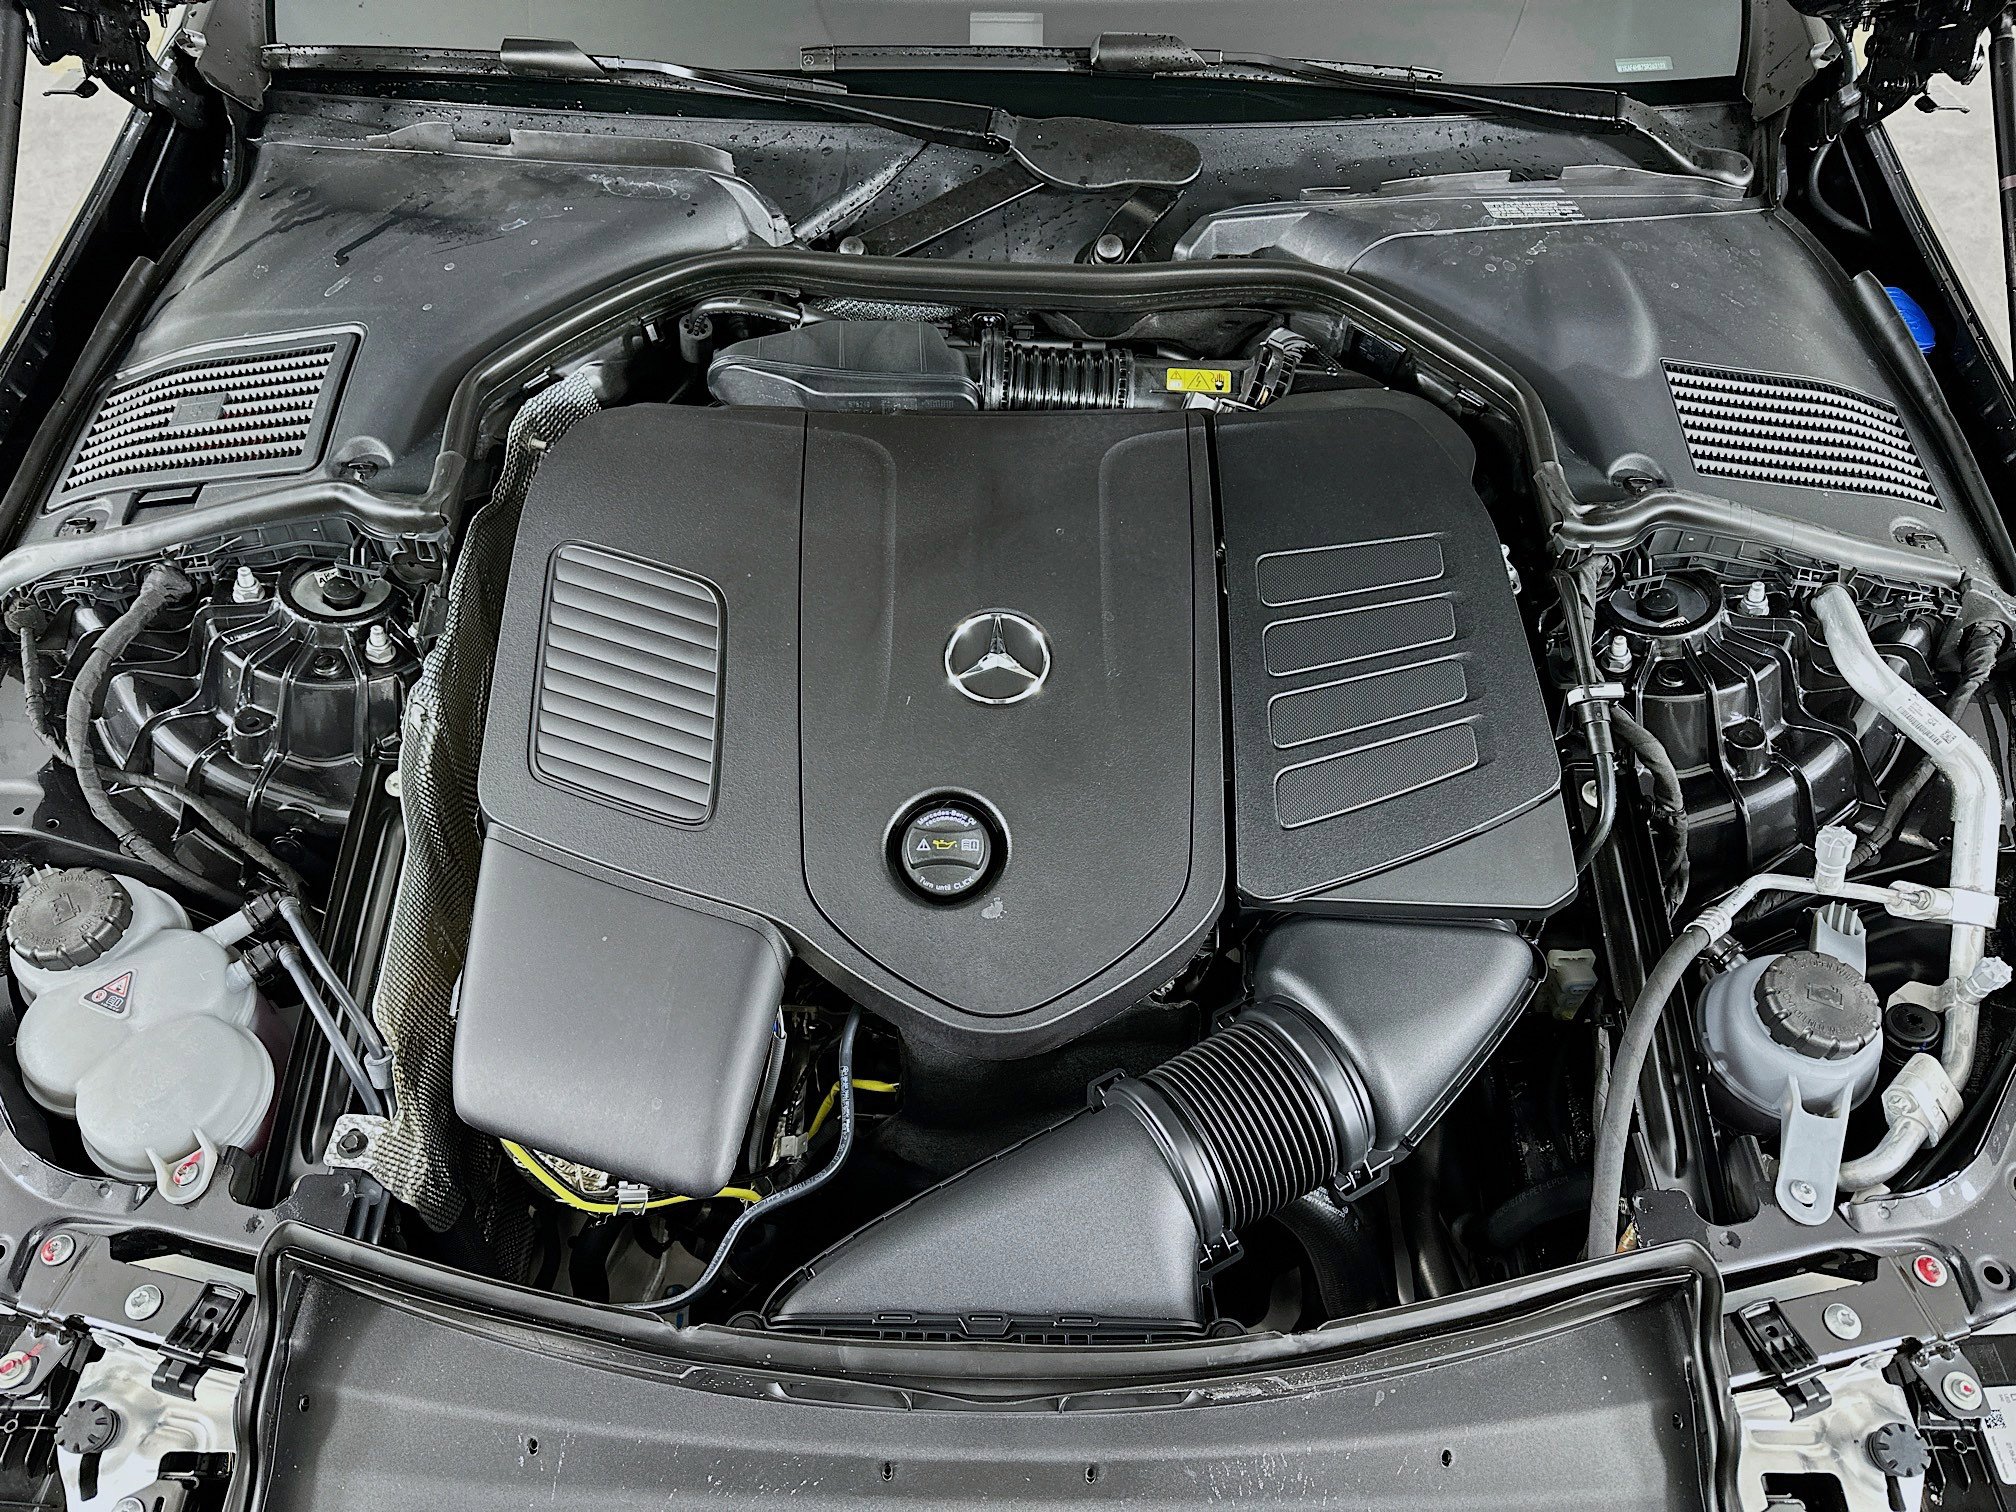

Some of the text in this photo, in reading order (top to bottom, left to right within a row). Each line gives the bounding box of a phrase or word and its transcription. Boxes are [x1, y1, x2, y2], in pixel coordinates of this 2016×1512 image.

[917, 810, 968, 826] Mercedes-Benz
[926, 816, 970, 827] recommended
[919, 875, 975, 891] Turn until CLICK
